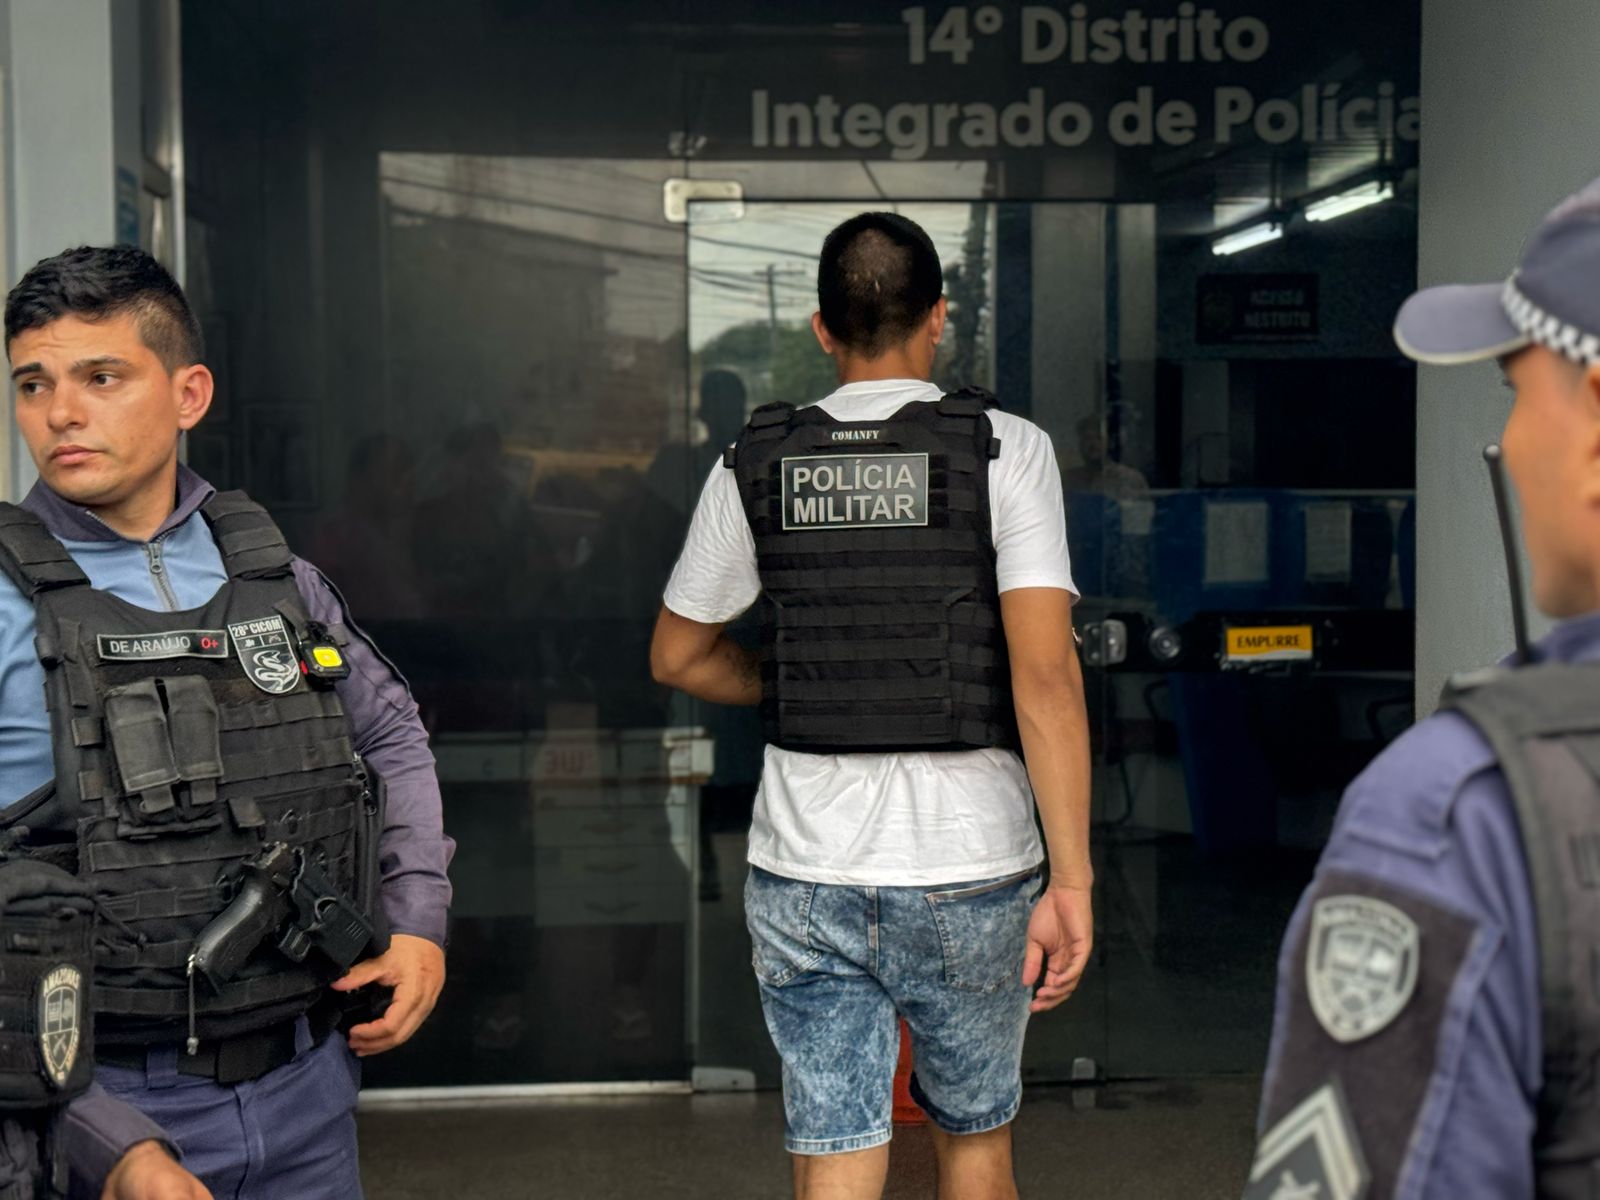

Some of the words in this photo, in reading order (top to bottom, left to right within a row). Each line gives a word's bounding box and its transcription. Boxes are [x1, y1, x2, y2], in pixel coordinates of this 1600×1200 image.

[1021, 2, 1270, 64] Distrito
[752, 86, 1093, 159] Integrado
[1107, 85, 1197, 146] de
[1214, 80, 1420, 144] Polícia
[793, 459, 916, 493] POLÍCIA
[794, 494, 916, 523] MILITAR
[249, 619, 281, 634] CICOM
[1236, 634, 1300, 648] EMPURRE
[110, 640, 129, 653] DE
[132, 635, 190, 653] ARAÚJO
